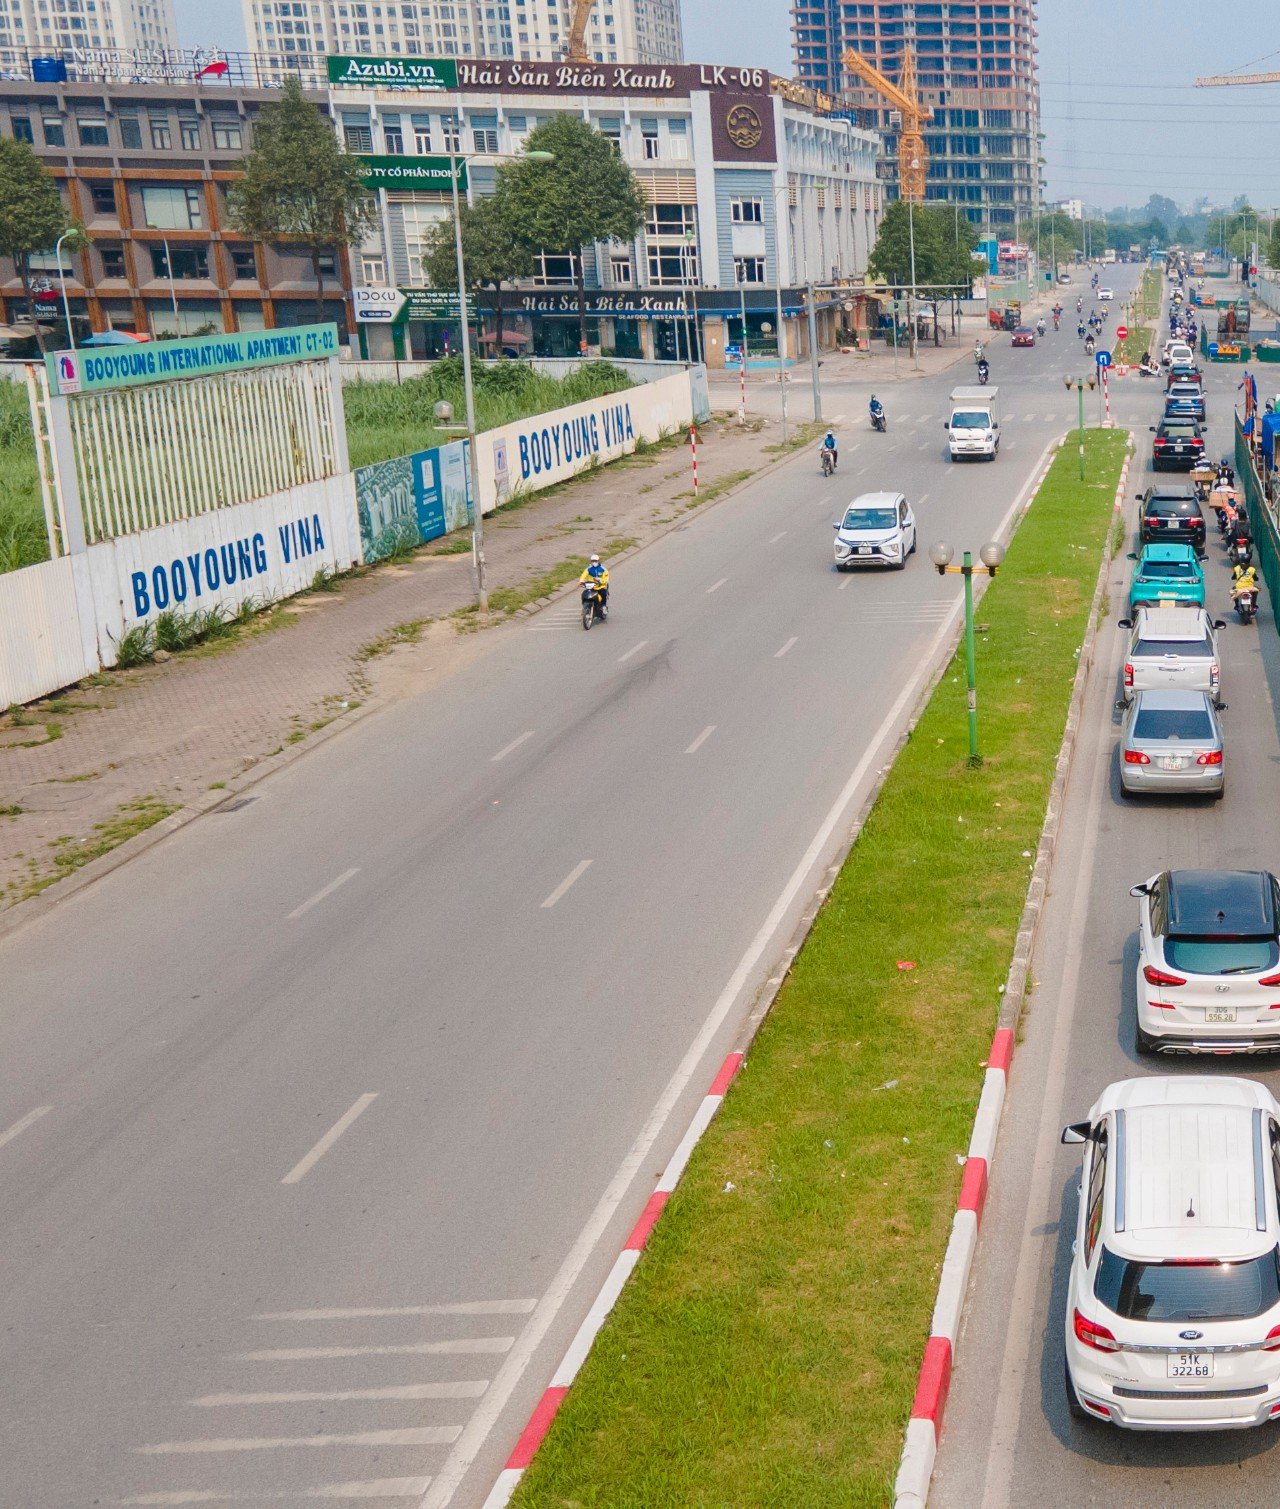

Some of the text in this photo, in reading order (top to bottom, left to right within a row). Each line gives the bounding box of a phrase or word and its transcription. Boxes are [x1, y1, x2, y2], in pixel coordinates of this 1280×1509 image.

[348, 60, 435, 78] Azubi.vn
[459, 63, 503, 85] Hải
[508, 64, 550, 86] Sản
[612, 67, 675, 89] Xanh
[373, 168, 387, 177] TY
[640, 296, 687, 311] Xanh
[85, 330, 334, 382] BOOYOUNG INTERNATIONAL APARTMENT CT-02
[519, 403, 634, 480] BOOYOUNG VINA
[131, 513, 325, 618] BOOYOUNG VINA
[1180, 1354, 1200, 1365] 51K
[1172, 1365, 1209, 1376] 322.68
